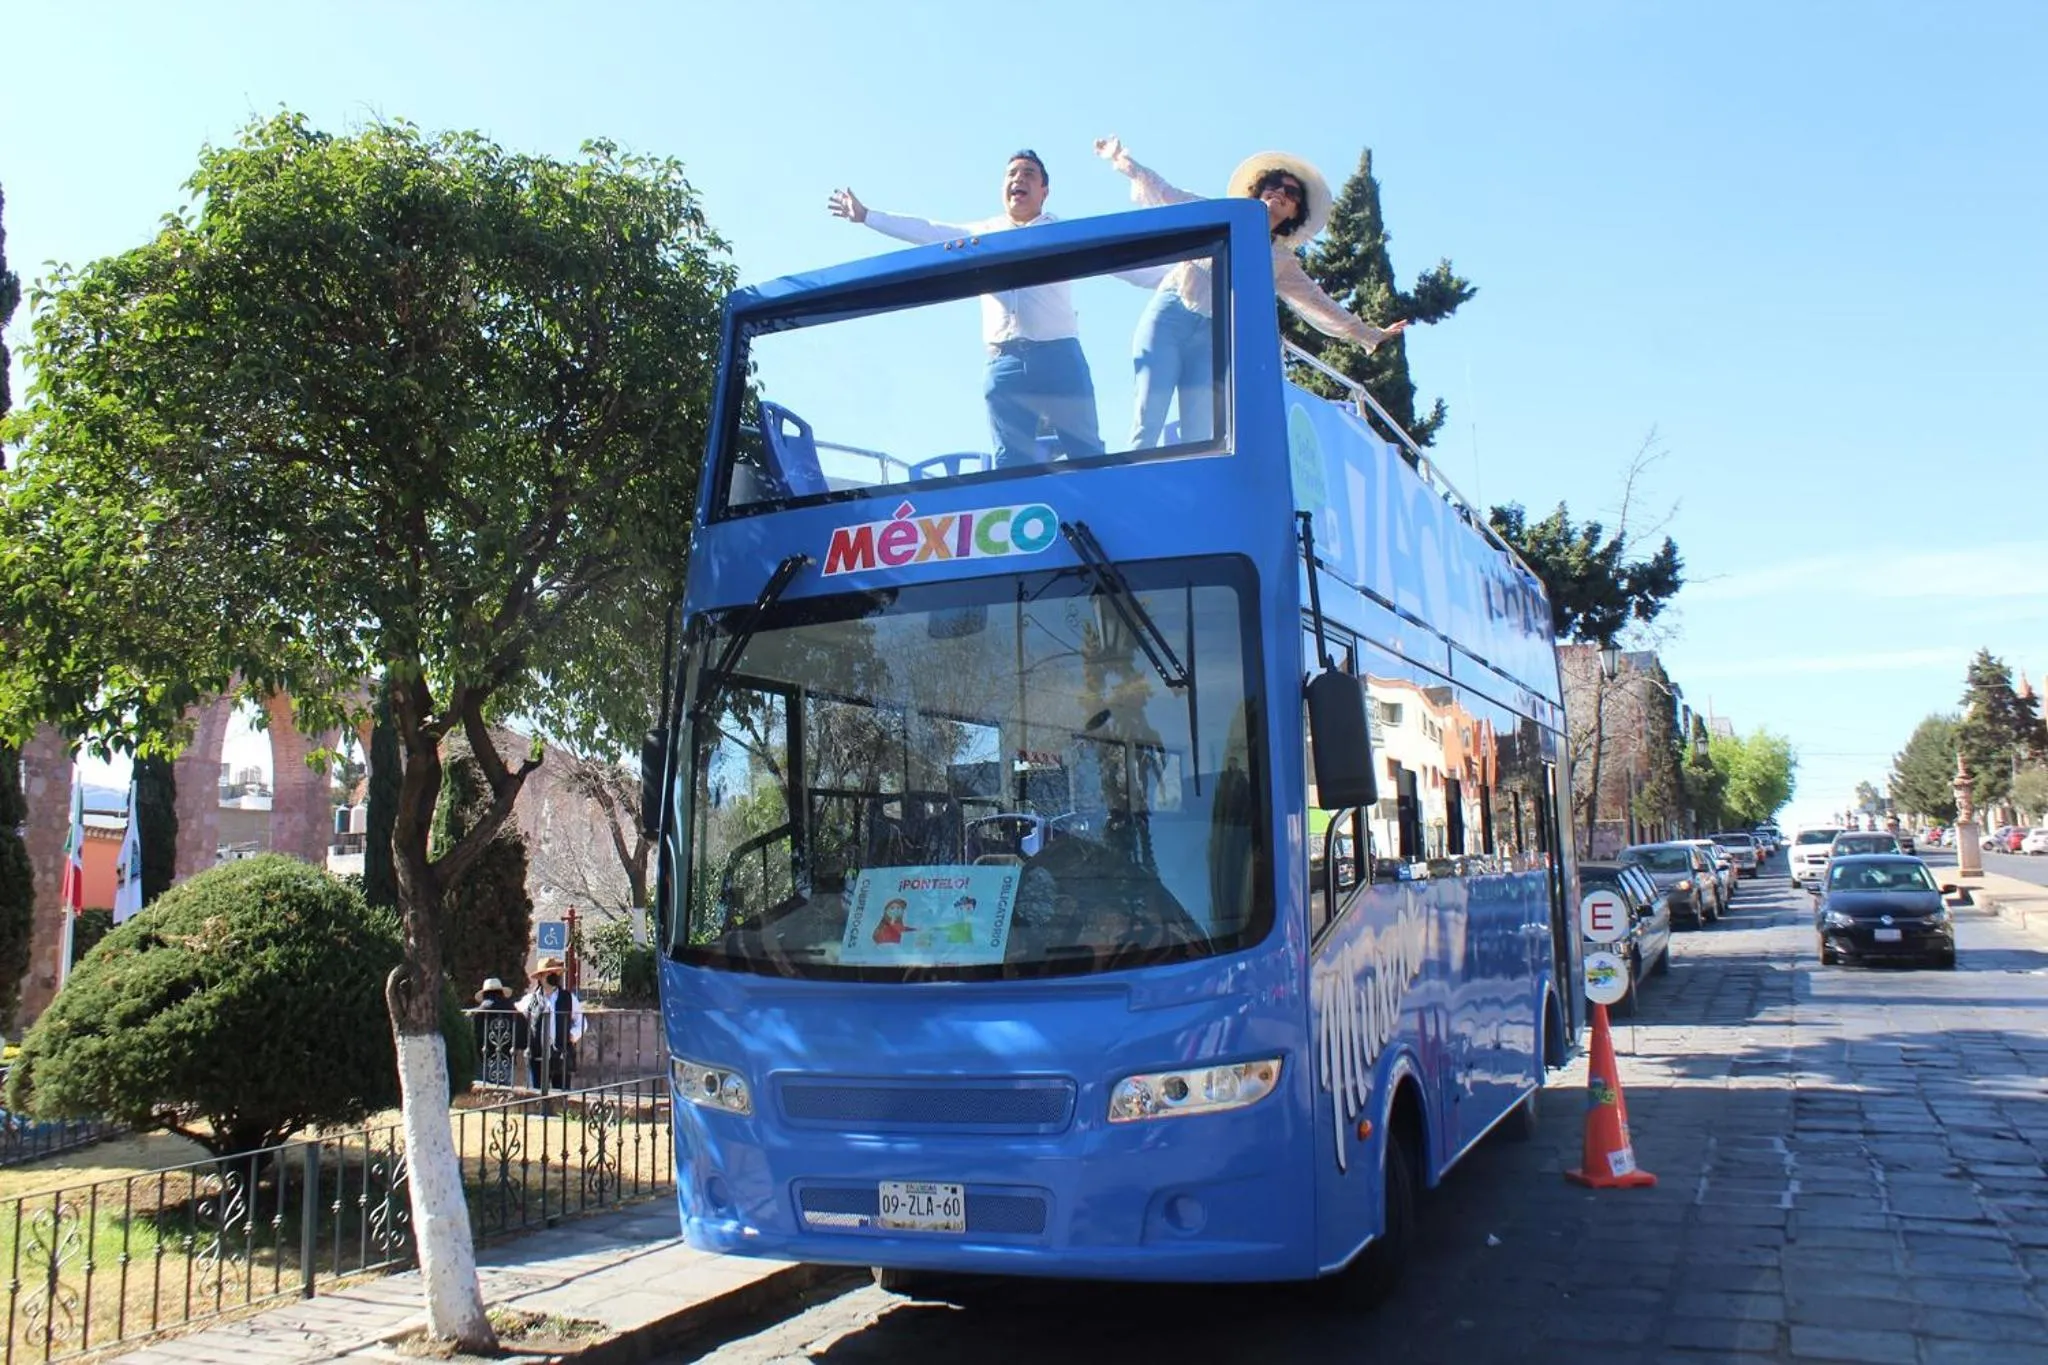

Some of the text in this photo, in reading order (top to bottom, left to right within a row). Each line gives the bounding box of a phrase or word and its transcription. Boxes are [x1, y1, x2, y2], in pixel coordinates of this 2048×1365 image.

[991, 877, 1012, 948] OBLIGATORIO
[1591, 902, 1614, 931] E
[882, 1195, 960, 1216] 09-ZLA-60
